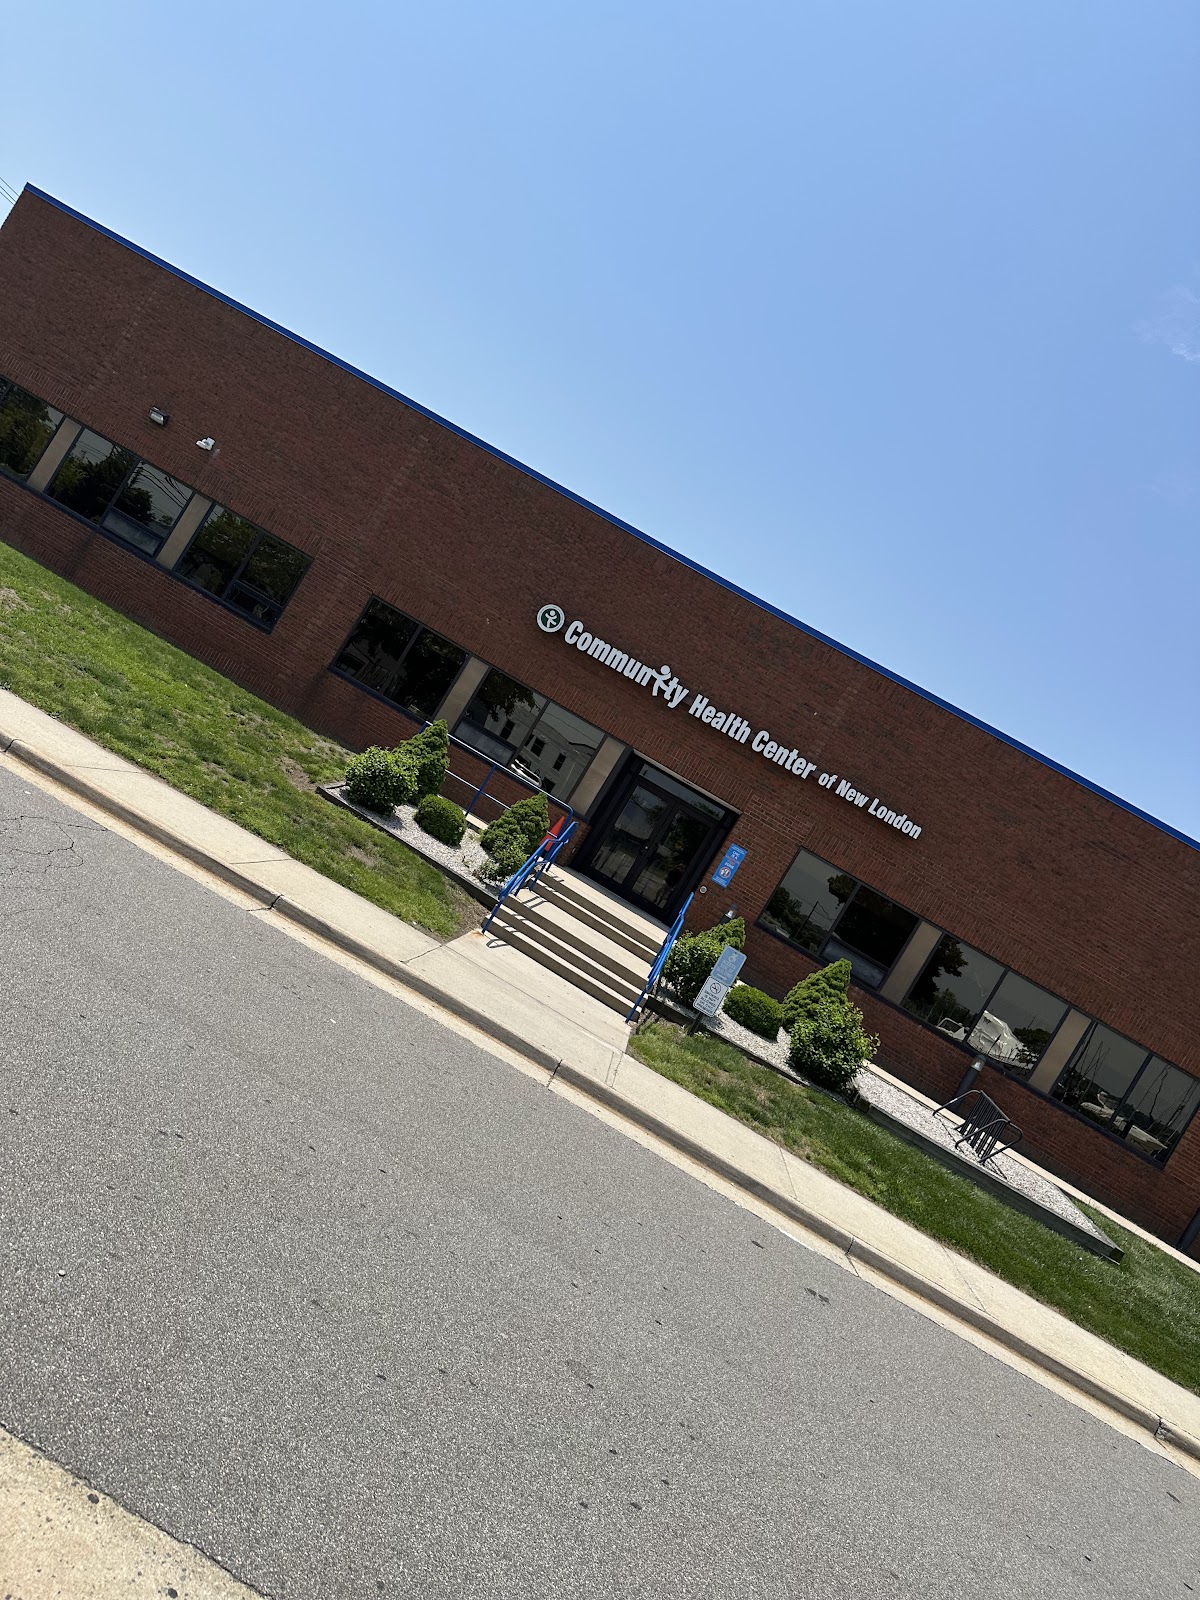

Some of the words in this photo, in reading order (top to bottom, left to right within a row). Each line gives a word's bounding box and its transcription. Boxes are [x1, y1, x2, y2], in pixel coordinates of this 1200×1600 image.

[564, 620, 690, 709] Community
[688, 693, 752, 744] Health
[751, 730, 818, 780] Center
[817, 772, 839, 790] of
[834, 778, 870, 808] New
[867, 797, 922, 840] London
[722, 959, 736, 969] ACCESS
[704, 989, 719, 1000] SMOKING
[700, 996, 716, 1007] ALLOWED
